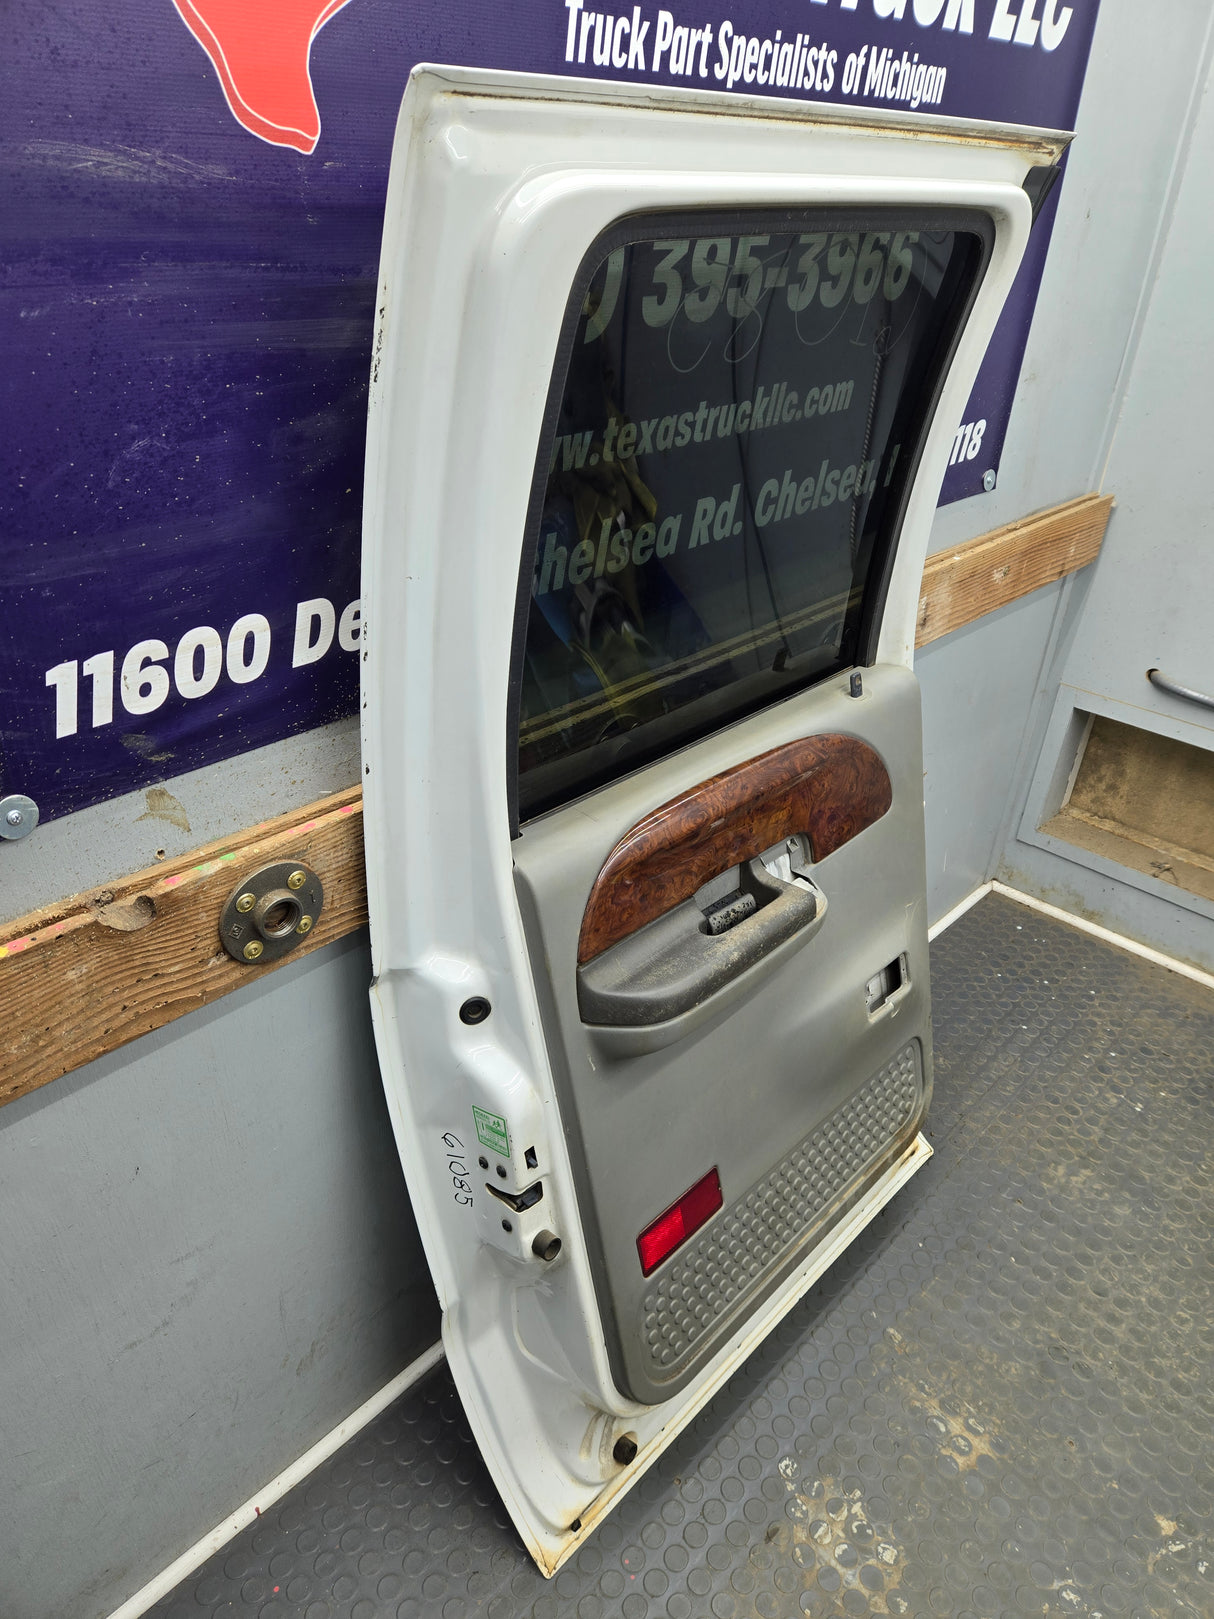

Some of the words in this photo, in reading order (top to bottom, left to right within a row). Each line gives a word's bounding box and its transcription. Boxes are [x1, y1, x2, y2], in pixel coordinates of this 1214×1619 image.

[564, 0, 650, 71] Truck
[651, 9, 713, 78] Part
[714, 20, 837, 89] Specialists
[841, 44, 869, 96] of
[863, 45, 947, 108] Michigan
[642, 232, 919, 328] 395-3966
[45, 613, 271, 740] 11600
[534, 512, 683, 596] helsea
[689, 483, 743, 550] Rd.
